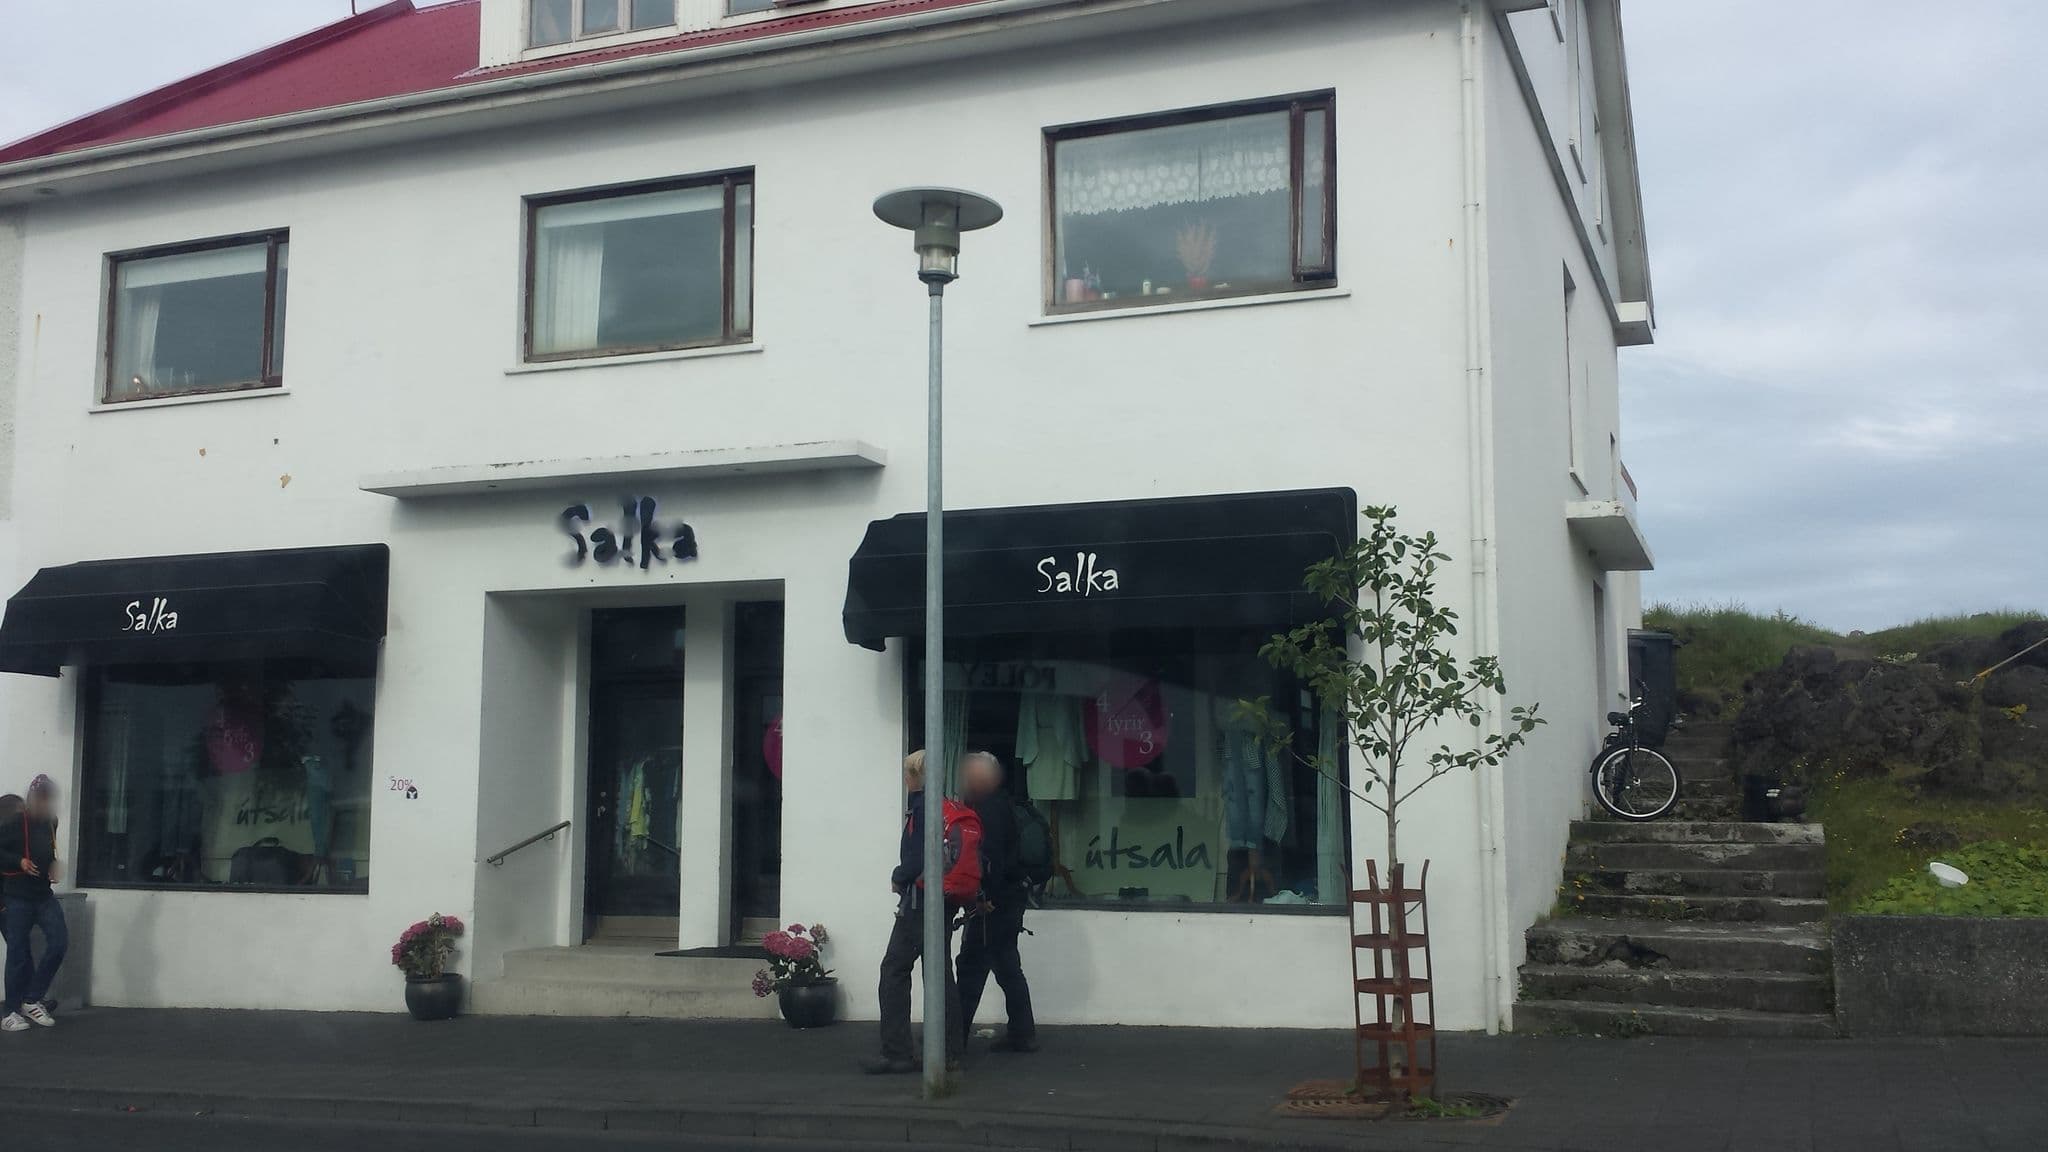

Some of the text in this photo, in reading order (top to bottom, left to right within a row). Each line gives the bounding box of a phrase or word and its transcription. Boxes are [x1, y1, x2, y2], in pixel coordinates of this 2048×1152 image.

[558, 496, 698, 569] Salka
[1037, 552, 1119, 597] Salka
[122, 597, 178, 634] Salka
[1095, 690, 1111, 713] 4
[1139, 730, 1154, 754] 3
[1086, 825, 1212, 871] útsala
